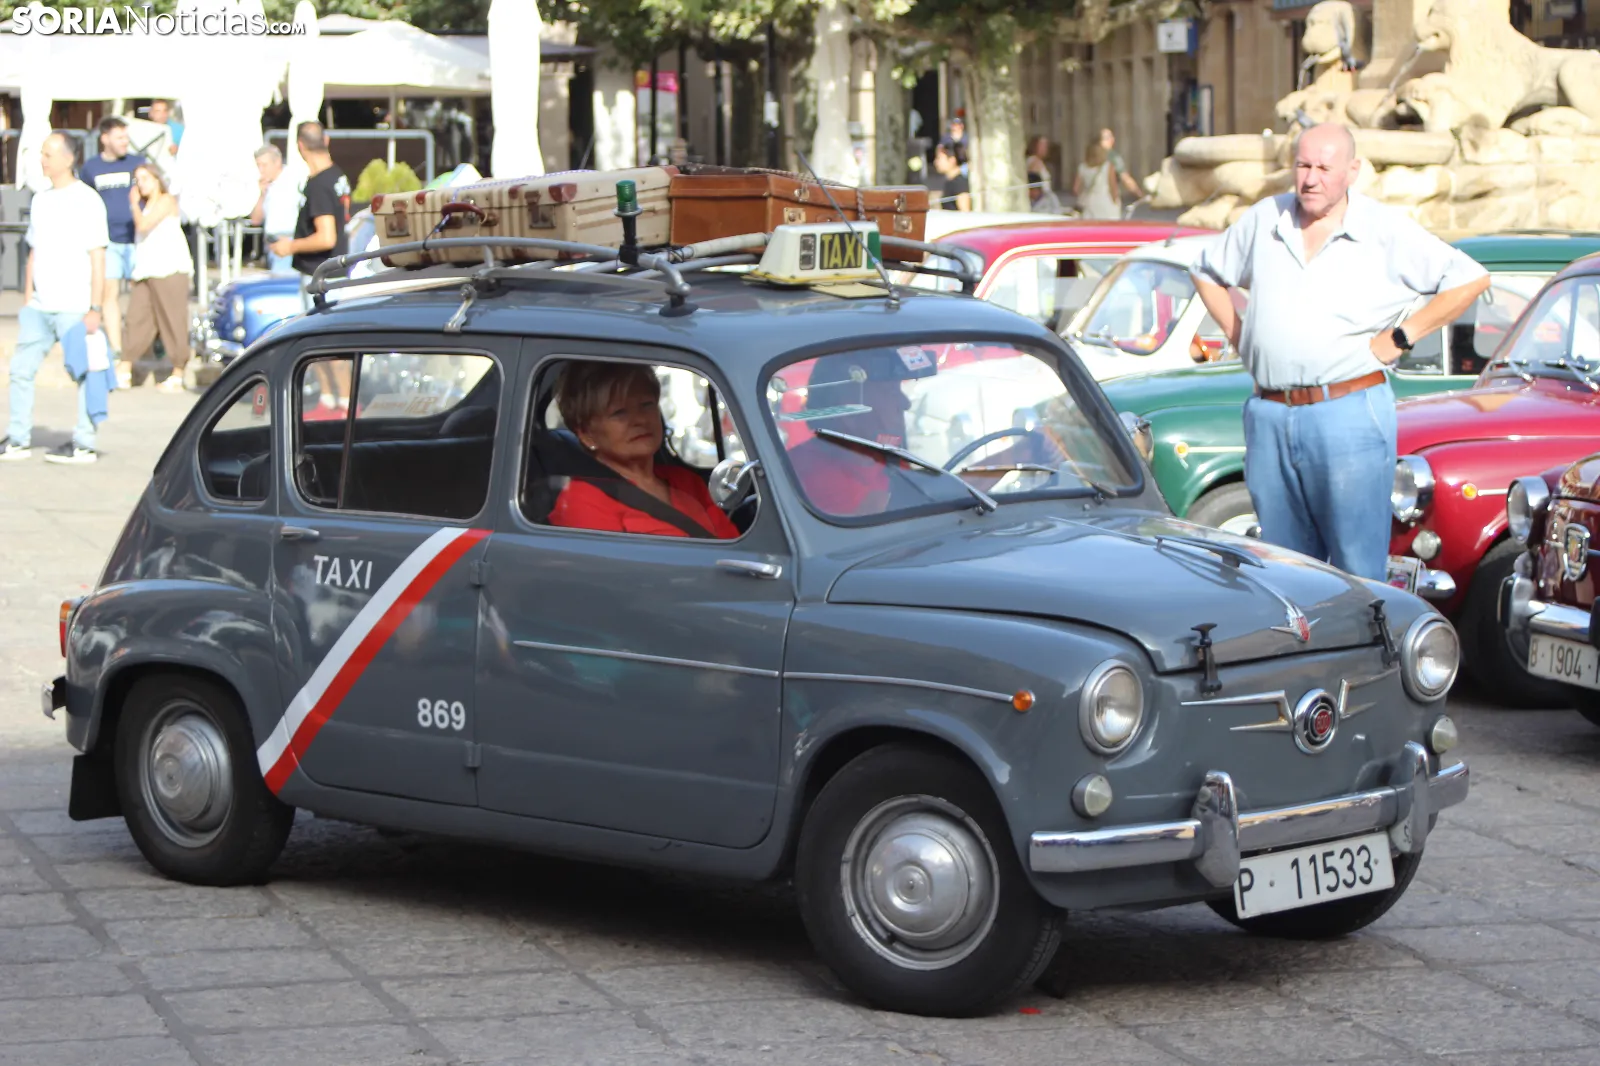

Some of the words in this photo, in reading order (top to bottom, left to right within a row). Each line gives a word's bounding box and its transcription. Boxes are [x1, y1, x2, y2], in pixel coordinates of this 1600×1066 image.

[821, 232, 863, 269] TAXI
[313, 554, 373, 590] TAXI
[1549, 642, 1582, 681] 1904
[417, 698, 466, 731] 869
[1238, 867, 1255, 911] P
[1290, 844, 1374, 900] 11533
